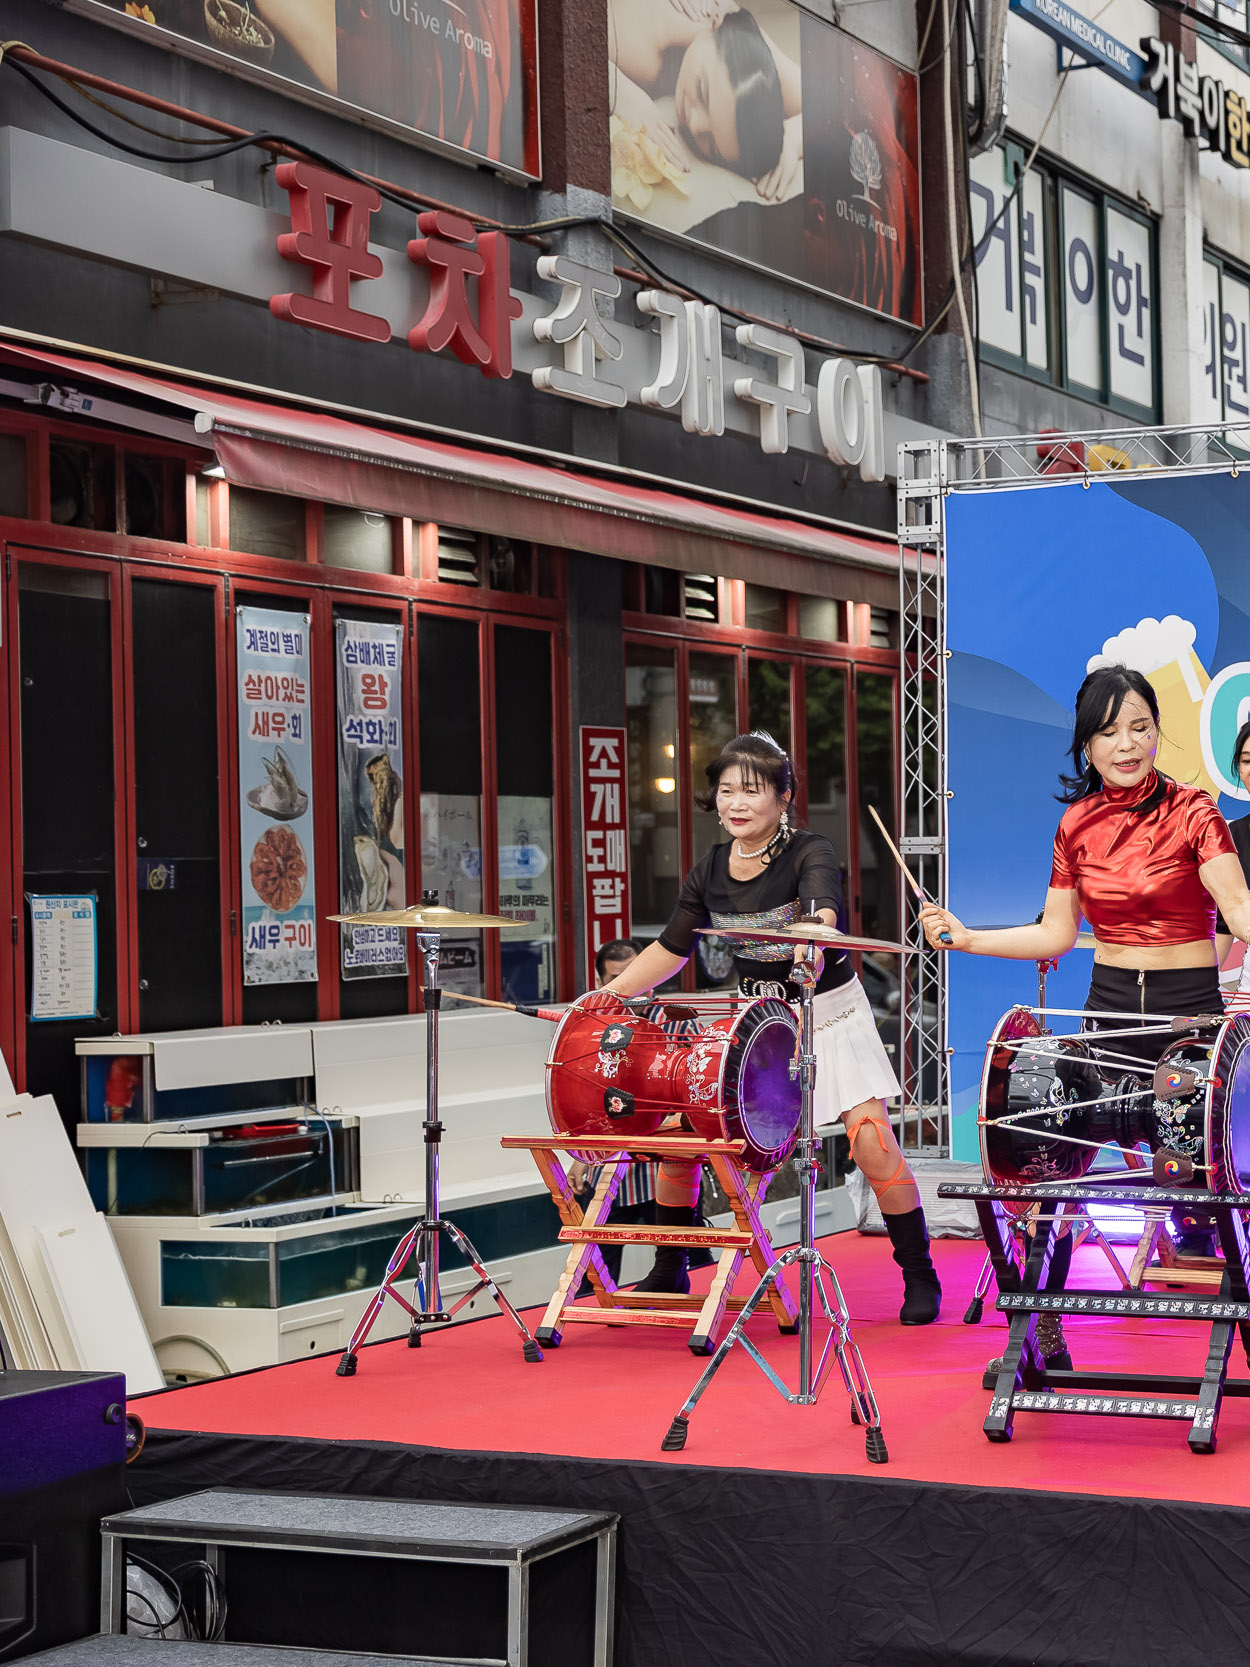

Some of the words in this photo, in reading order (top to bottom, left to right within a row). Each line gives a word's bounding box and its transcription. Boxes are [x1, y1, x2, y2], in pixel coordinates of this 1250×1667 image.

[444, 19, 493, 60] Aroma
[1070, 14, 1106, 55] MEDICAL
[1105, 39, 1131, 72] CLINIC
[836, 199, 867, 229] Olive
[867, 213, 898, 242] Aroma
[270, 160, 523, 380] 포차
[245, 628, 281, 654] 계절의
[344, 640, 397, 667] 삼배체굴
[244, 673, 306, 705] 살아있는
[361, 673, 389, 710] 왕
